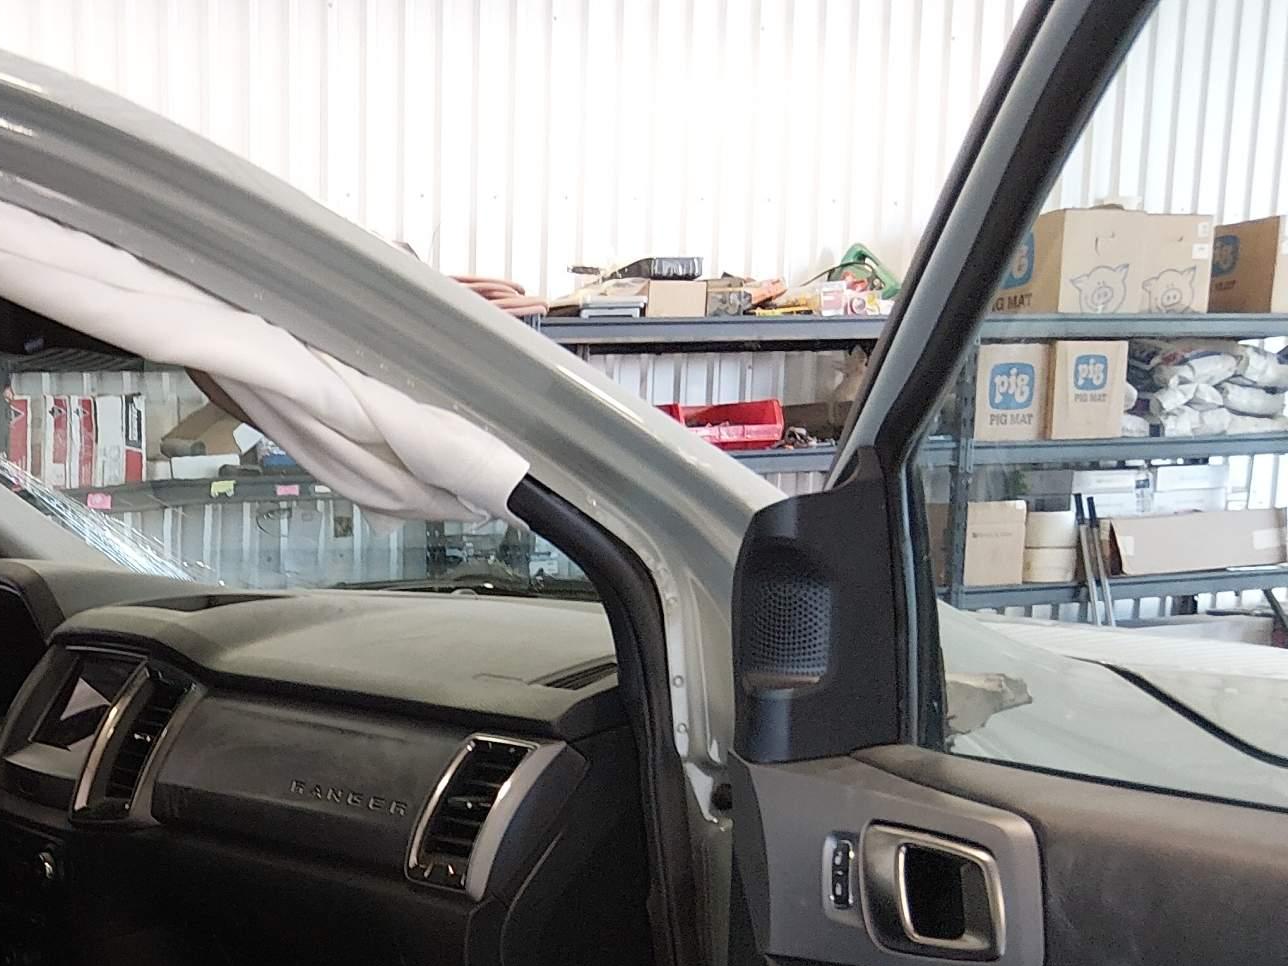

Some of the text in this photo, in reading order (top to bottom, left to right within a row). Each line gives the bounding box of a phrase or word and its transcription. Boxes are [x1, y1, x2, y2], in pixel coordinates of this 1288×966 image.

[993, 367, 1030, 404] pig
[1077, 358, 1105, 386] pig
[1074, 393, 1108, 402] PIG MAT
[989, 413, 1034, 426] PIG MAT
[290, 779, 408, 816] RANGER
